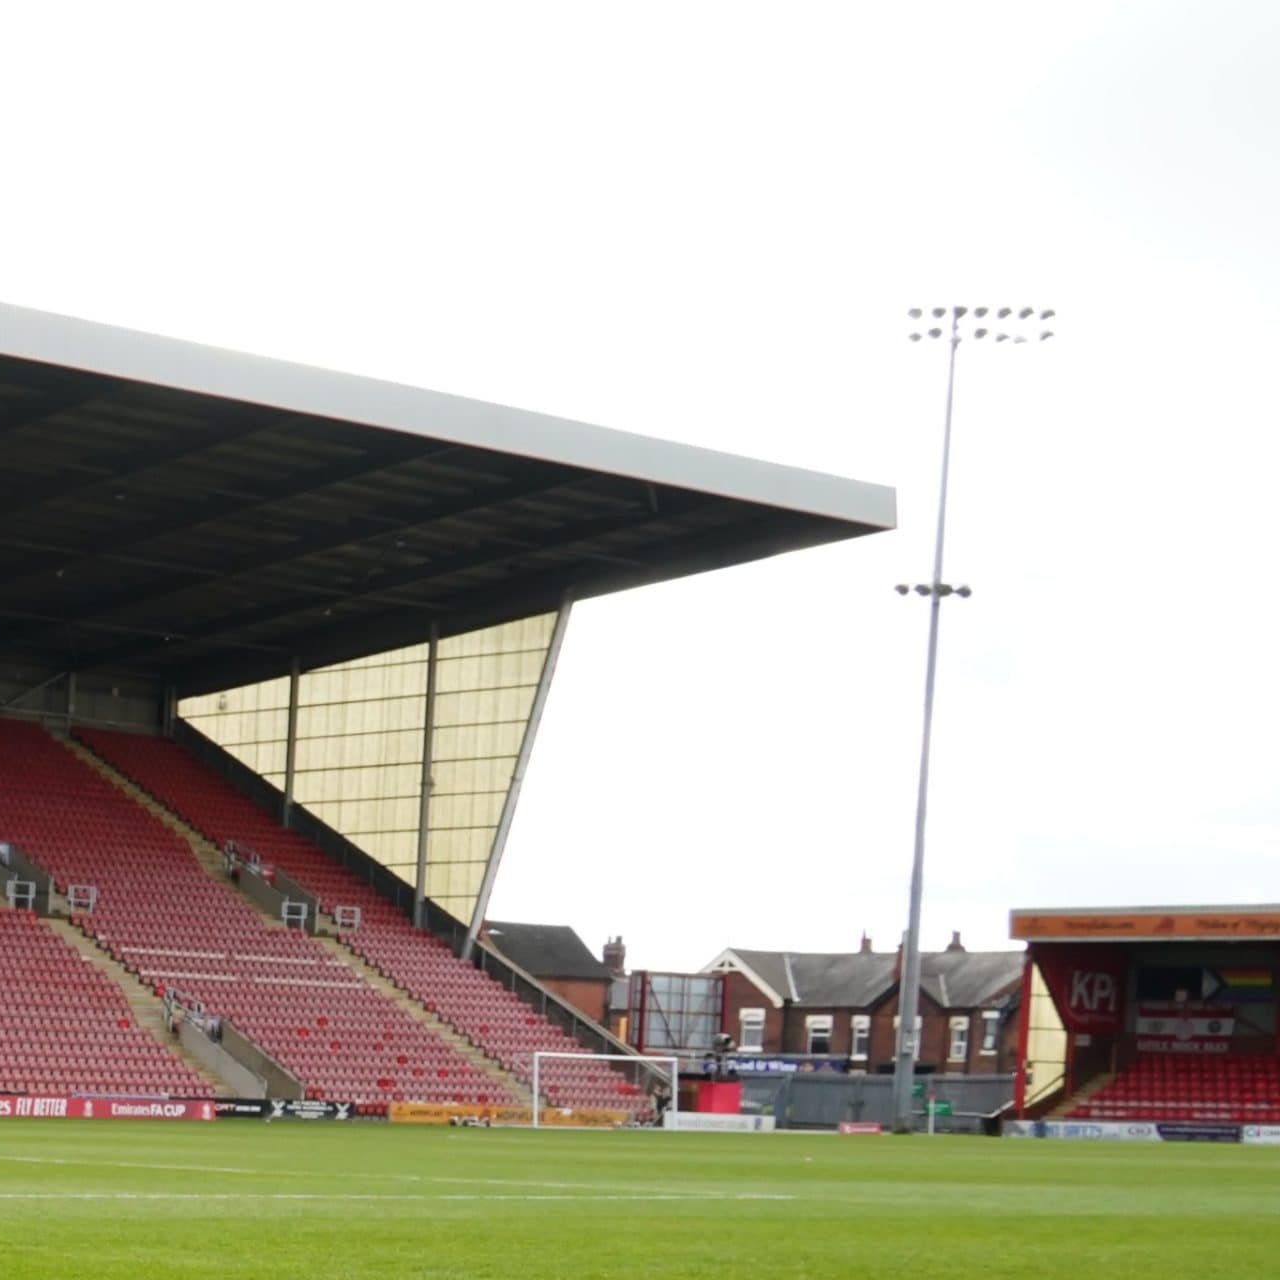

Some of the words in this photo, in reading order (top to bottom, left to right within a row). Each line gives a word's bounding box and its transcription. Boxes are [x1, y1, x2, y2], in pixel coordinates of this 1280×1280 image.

[16, 1098, 33, 1115] FLY
[33, 1098, 67, 1116] BETTER
[111, 1103, 150, 1116] Emirates
[150, 1104, 163, 1117] FA
[164, 1105, 186, 1117] CUP
